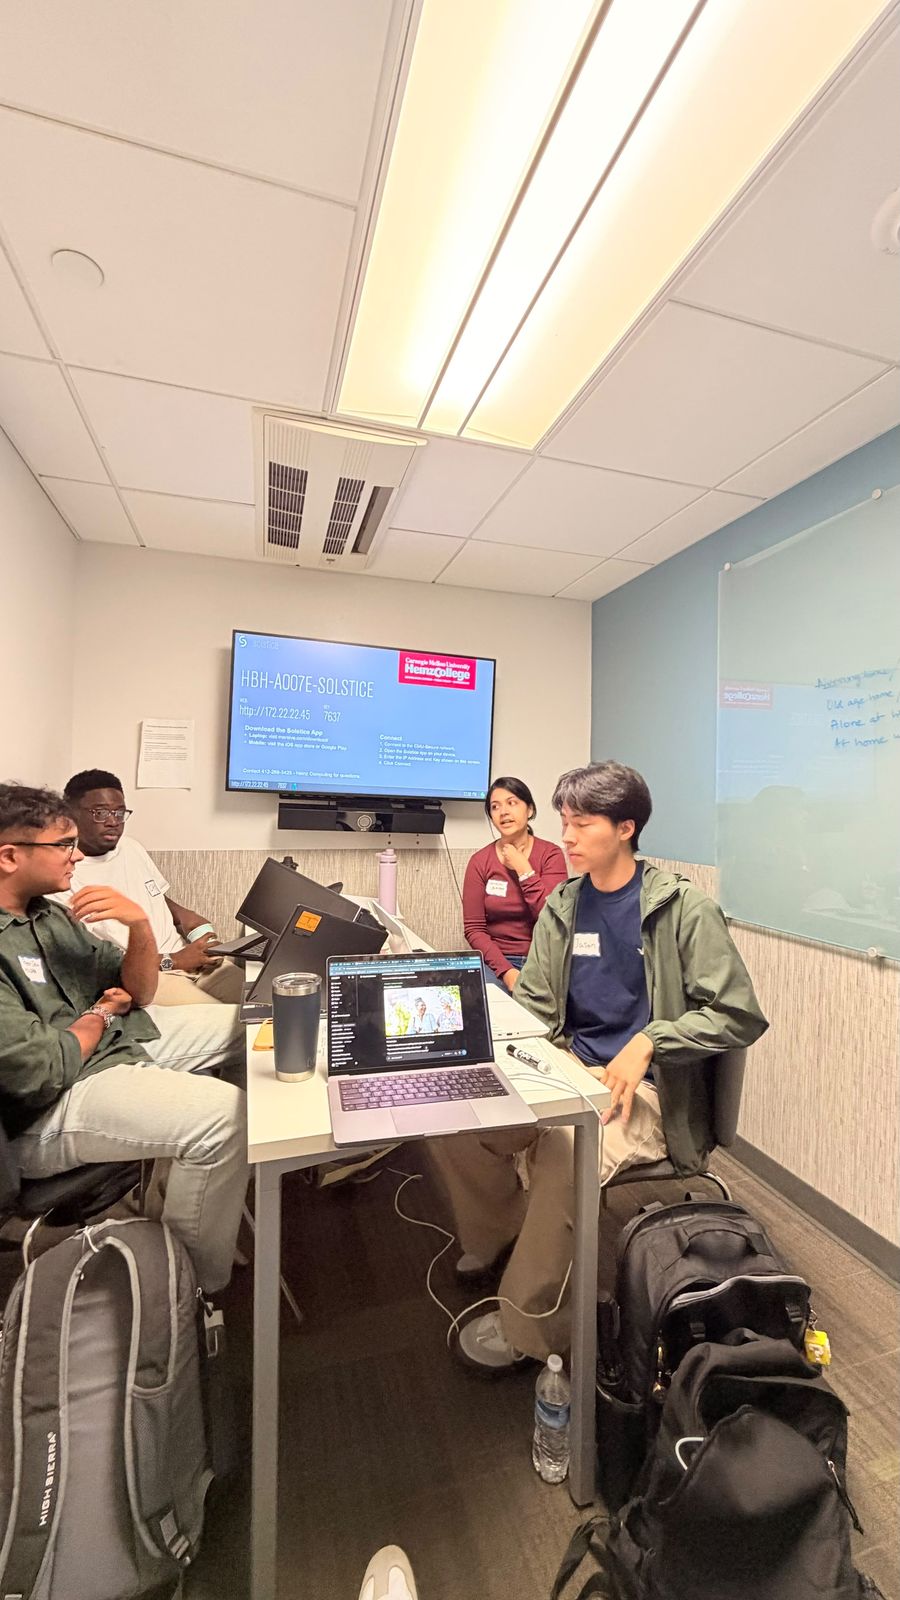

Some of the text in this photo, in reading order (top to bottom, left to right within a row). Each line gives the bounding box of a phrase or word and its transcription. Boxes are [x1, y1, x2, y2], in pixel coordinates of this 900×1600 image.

[405, 657, 471, 671] Carnegie Mellon University
[241, 669, 374, 698] HBH-A007E-SOLSTICE
[239, 705, 311, 720] http://172.22.22.45
[324, 711, 341, 722] 7637
[244, 725, 275, 733] Download
[39, 1488, 52, 1526] HIGH
